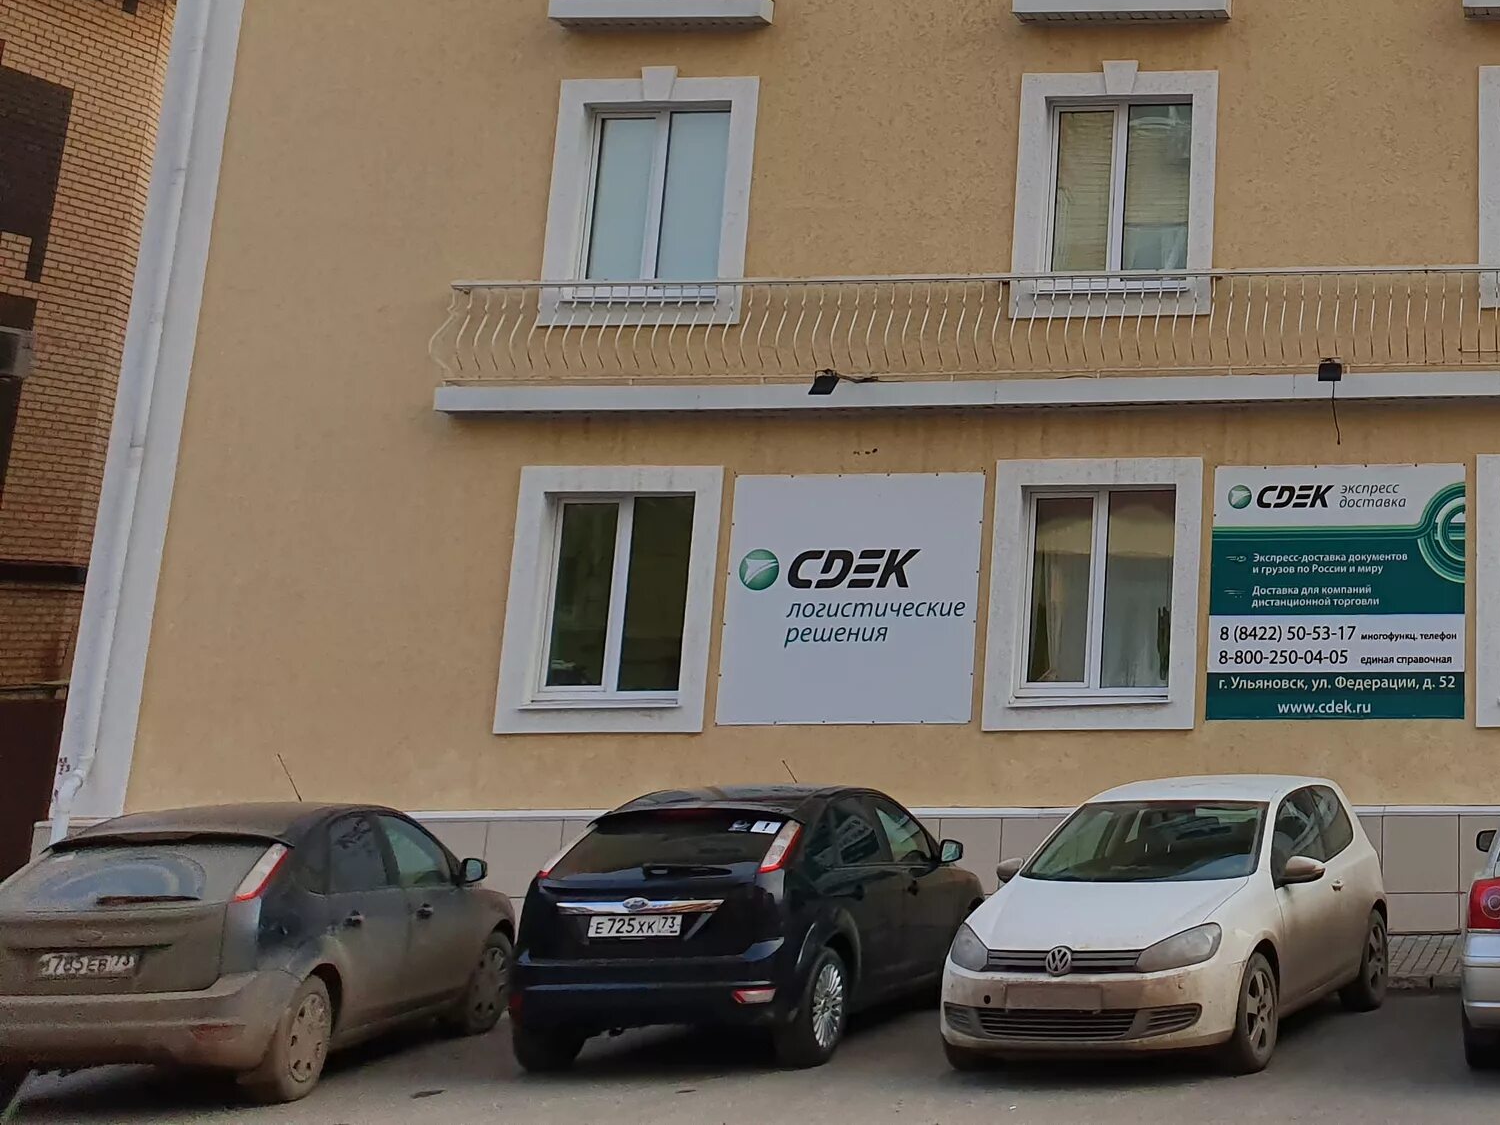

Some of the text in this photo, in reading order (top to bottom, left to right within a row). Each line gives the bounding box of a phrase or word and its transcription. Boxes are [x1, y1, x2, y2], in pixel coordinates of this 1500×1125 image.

[1340, 484, 1400, 495] экспресс
[1256, 485, 1334, 509] CDEK
[1339, 497, 1406, 508] доставка
[1252, 552, 1408, 563] Экспресс-доставка документов
[787, 549, 921, 588] CDEK
[1261, 566, 1295, 575] грузов
[1312, 564, 1346, 573] России
[1357, 565, 1383, 575] миру
[1252, 584, 1372, 596] Доставка для компаний
[786, 601, 966, 618] логистические
[1251, 597, 1380, 608] дистанционной торговли
[784, 626, 888, 648] решения
[1220, 625, 1457, 643] 8 (8422) 50-53-17 многофункц. телефон
[1219, 650, 1452, 666] 8-800-250-04-05 единая справочная
[1219, 676, 1456, 691] г. Ульяновск, ул. Федерации, д. 52
[1278, 700, 1371, 714] www.cdek.ru
